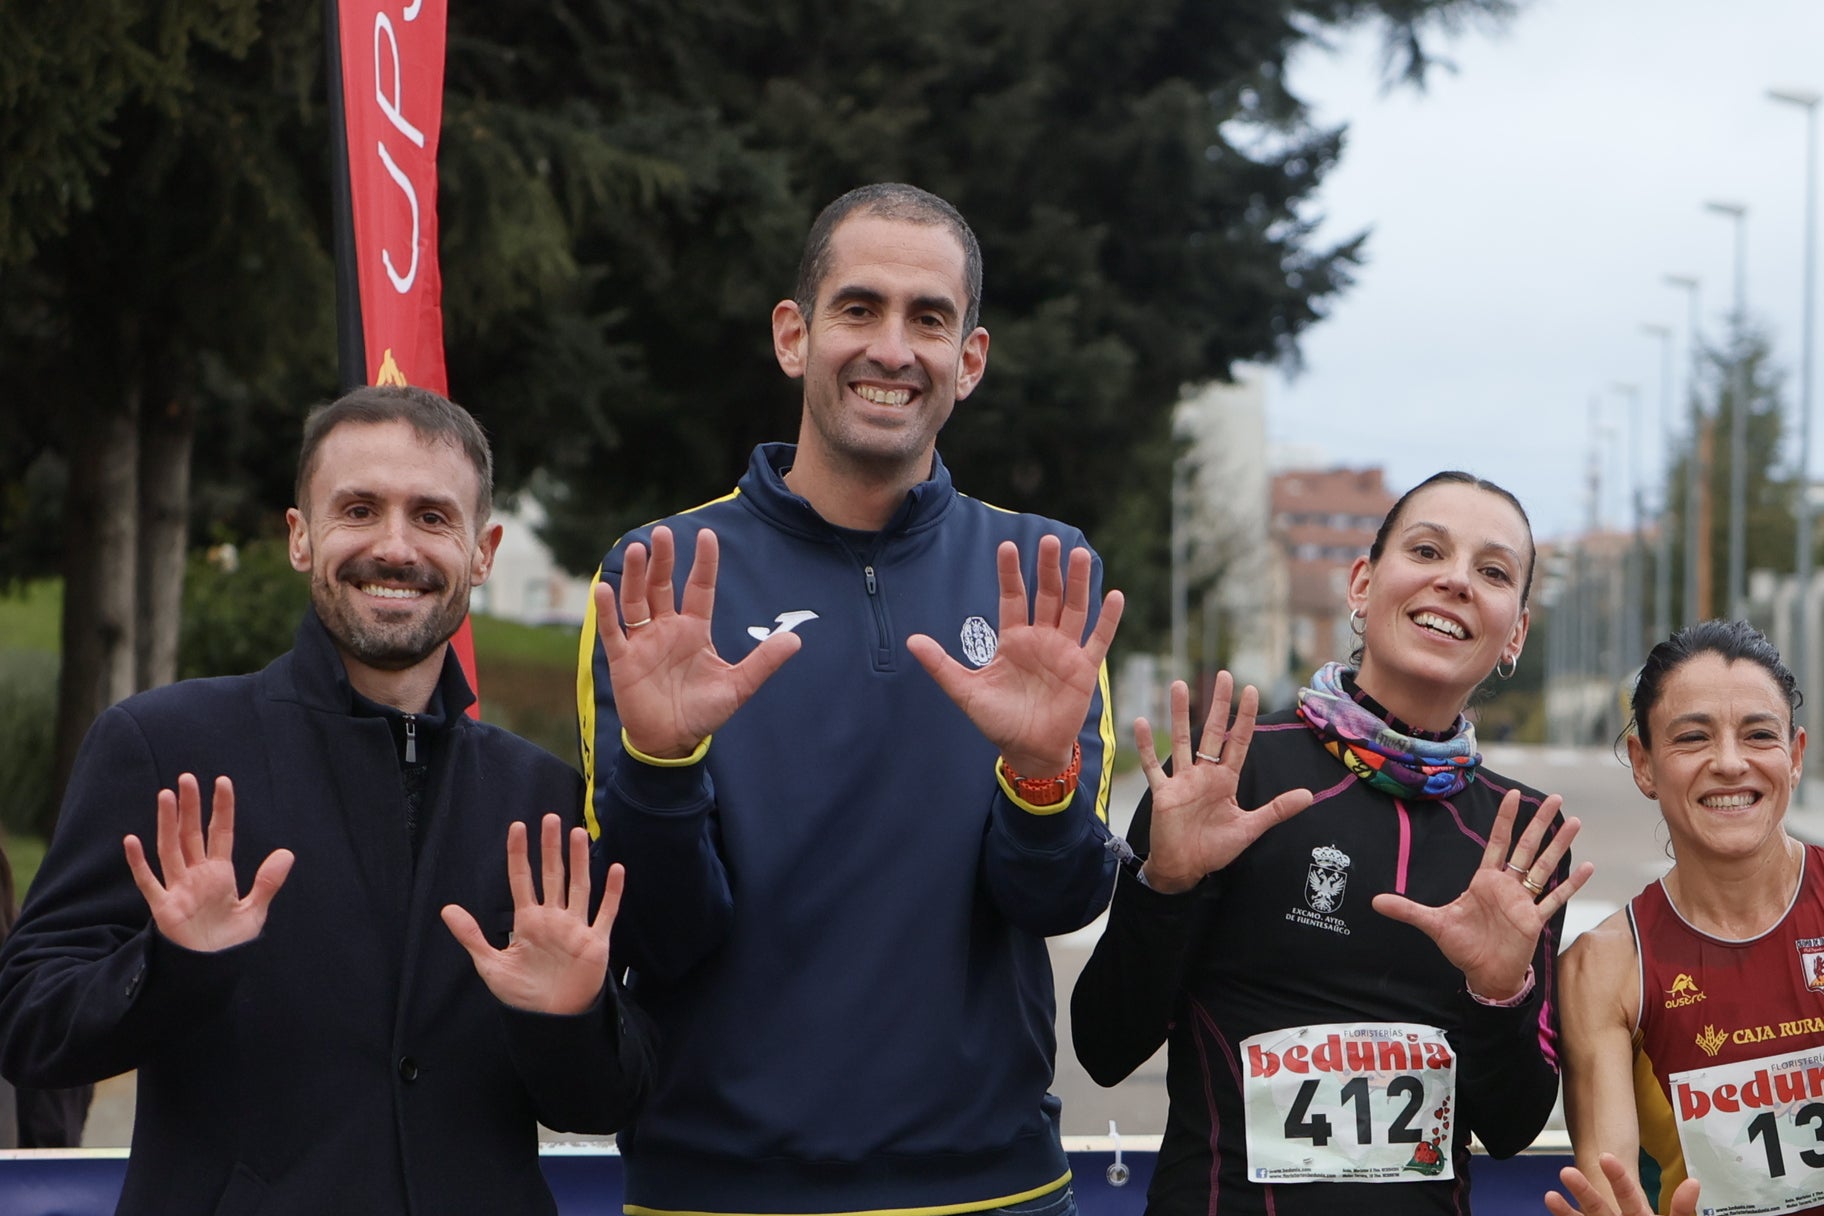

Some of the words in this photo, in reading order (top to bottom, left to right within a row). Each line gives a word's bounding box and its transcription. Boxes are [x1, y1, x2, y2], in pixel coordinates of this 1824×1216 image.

[374, 0, 425, 294] UP
[1285, 913, 1296, 921] DE
[1292, 907, 1323, 920] EXCMO.
[1324, 916, 1347, 927] AYTO.
[1343, 1028, 1404, 1039] FLORISTERÍAS
[1732, 1026, 1777, 1045] CAJA
[1247, 1031, 1452, 1079] bedunia
[1284, 1075, 1426, 1147] 412
